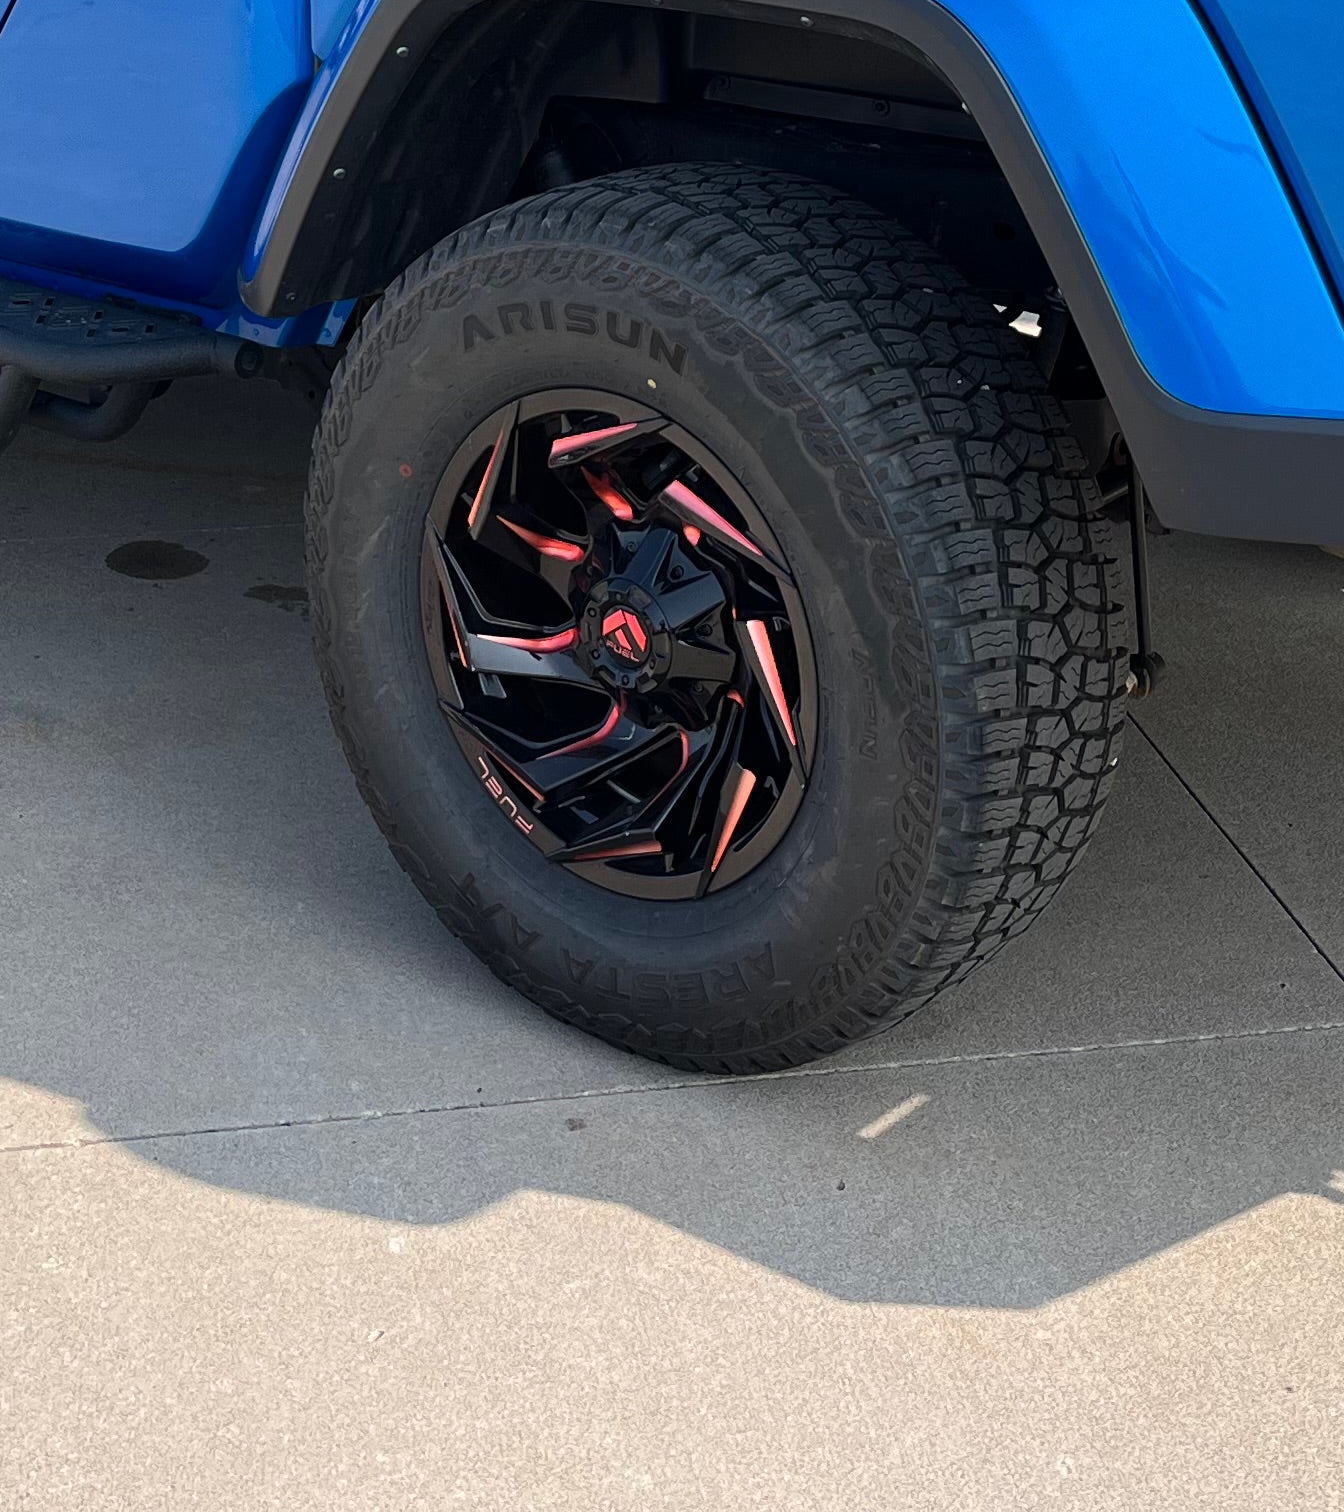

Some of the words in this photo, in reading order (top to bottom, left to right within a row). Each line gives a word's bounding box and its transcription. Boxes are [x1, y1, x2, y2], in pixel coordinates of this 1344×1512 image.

[462, 300, 689, 376] ARISUN
[606, 639, 640, 663] FUEL
[478, 756, 534, 835] FUEL
[560, 941, 775, 1006] ARESTA
